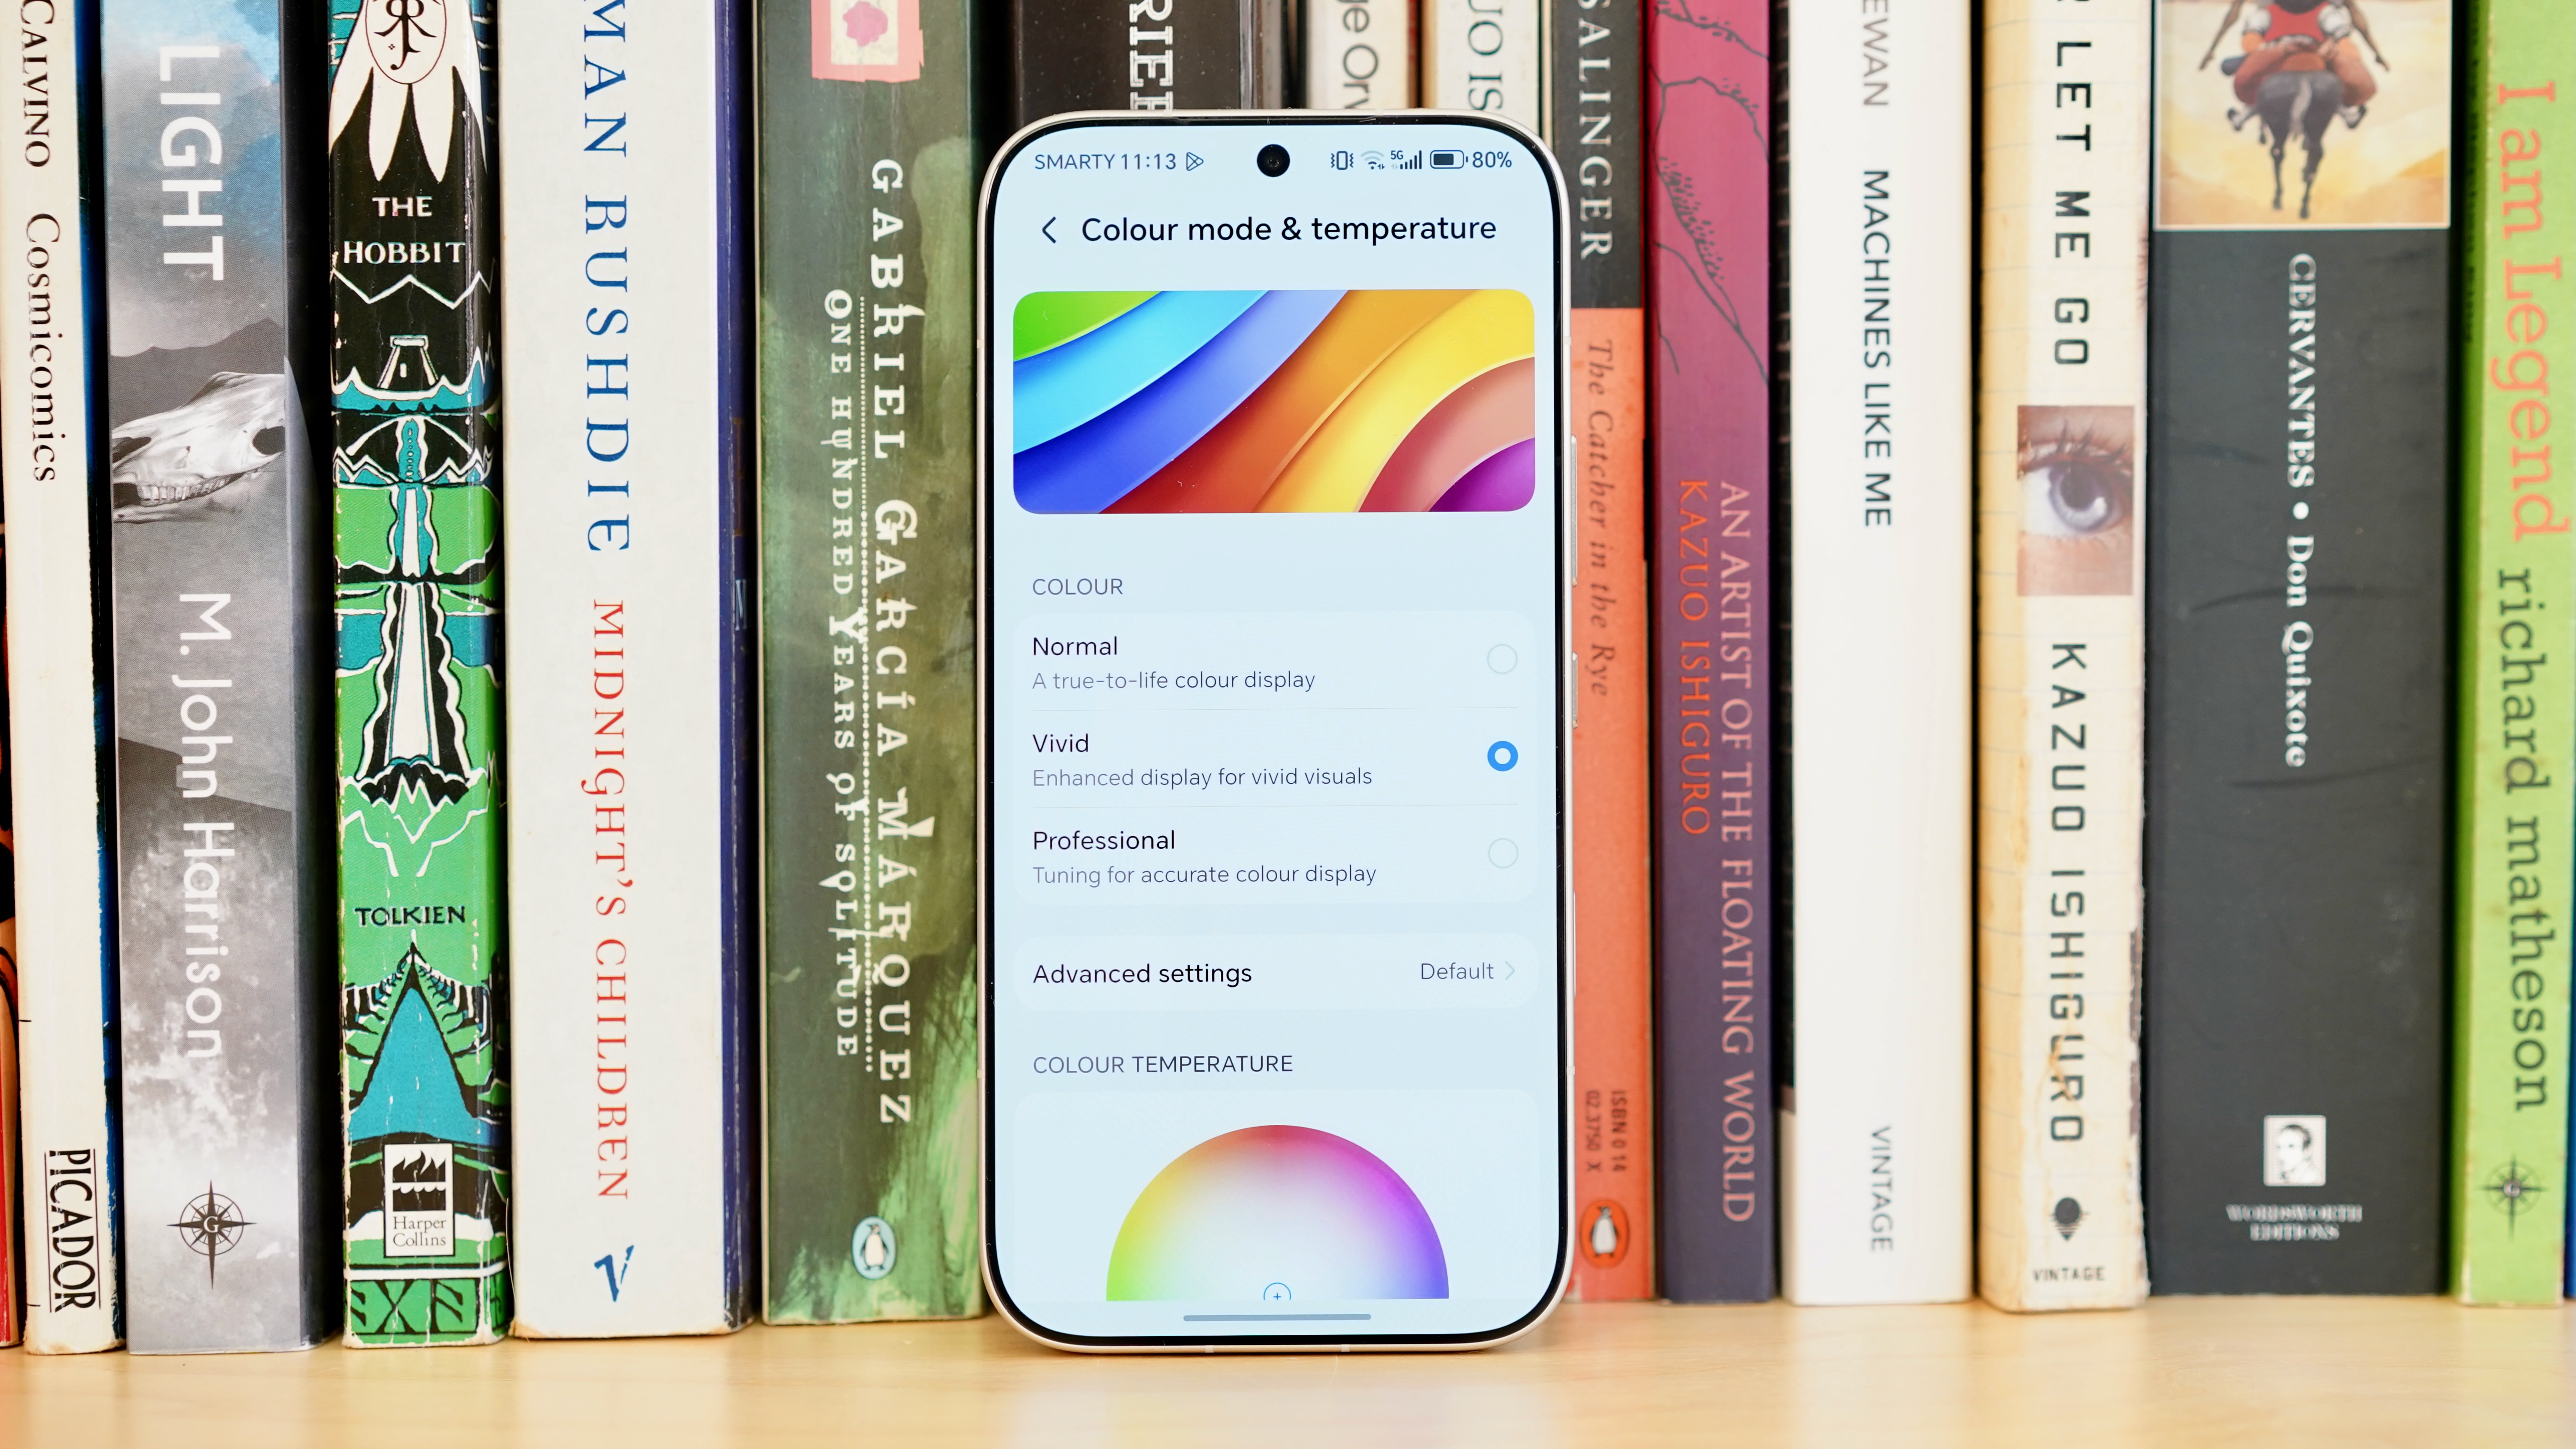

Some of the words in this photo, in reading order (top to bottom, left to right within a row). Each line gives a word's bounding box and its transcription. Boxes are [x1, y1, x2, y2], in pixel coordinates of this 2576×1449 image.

[21, 0, 54, 167] CALVINO
[2057, 42, 2091, 151] LET
[2497, 81, 2555, 105] I
[159, 46, 224, 280] LIGHT
[1035, 154, 1115, 169] SMARTY
[1122, 153, 1176, 170] 11:13
[1391, 150, 1403, 160] 5G
[1473, 151, 1512, 168] 80%
[2499, 128, 2543, 239] am
[372, 196, 432, 217] THE
[1082, 217, 1178, 241] Colour
[1189, 217, 1271, 240] mode
[1282, 217, 1301, 240] &
[1312, 217, 1496, 245] temperature
[2056, 192, 2090, 257] ME
[343, 242, 466, 264] HOBBIT
[1864, 171, 1890, 368] MACHINES
[824, 289, 852, 373] ONE
[871, 160, 926, 458] GABRIEL
[2055, 298, 2089, 364] GO
[26, 213, 65, 481] Cosmicomics
[586, 195, 629, 551] RUSHDIE
[1588, 340, 1614, 394] The
[2288, 254, 2315, 488] CERVANTES
[1865, 384, 1890, 458] LIKE
[2490, 257, 2570, 542] Legend
[821, 396, 858, 595] HUNDRED
[1589, 411, 1615, 528] Catcher
[1866, 474, 1891, 526] ME
[1721, 481, 1750, 537] AN
[1033, 578, 1122, 595] COLOUR
[1590, 541, 1608, 568] in
[1680, 480, 1708, 620] KAZUO
[2287, 536, 2314, 607] Don
[180, 593, 232, 655] M.
[875, 500, 917, 756] GARCÍA
[1591, 583, 1617, 628] the
[1721, 551, 1751, 688] ARTIST
[829, 607, 865, 749] YEARS
[1032, 673, 1046, 689] A
[1053, 671, 1167, 689] true-to-life
[1176, 671, 1238, 688] colour
[1245, 671, 1315, 692] display
[1034, 636, 1116, 655] Normal
[1586, 644, 1615, 696] Rye
[2499, 569, 2551, 794] richard
[1722, 699, 1752, 749] OF
[2282, 621, 2313, 767] Quixote
[172, 674, 233, 798] John
[581, 600, 633, 915] MIDNIGHT'S
[1033, 734, 1088, 752] Vivid
[1681, 641, 1710, 834] ISHIGURO
[2052, 644, 2086, 831] KAZUO
[826, 772, 866, 821] OF
[1034, 769, 1133, 786] Enhanced
[1142, 768, 1211, 789] display
[1219, 768, 1245, 785] for
[1252, 768, 1296, 784] vivid
[1305, 767, 1371, 784] visuals
[1722, 762, 1752, 841] THE
[1033, 867, 1100, 887] Tuning
[1108, 866, 1134, 883] for
[1142, 867, 1229, 883] accurate
[1237, 865, 1299, 882] colour
[1306, 865, 1376, 886] display
[1035, 830, 1174, 850] Professional
[182, 822, 235, 1058] Harrison
[355, 906, 465, 926] TOLKIEN
[818, 844, 862, 1056] SOLITUDE
[872, 787, 935, 1123] MÁRQUEZ
[1034, 964, 1149, 983] Advanced
[1160, 964, 1251, 987] settings
[1422, 962, 1494, 979] Default
[1722, 860, 1753, 1053] FLOATING
[2507, 817, 2555, 1111] matheson
[2051, 870, 2084, 1141] ISHIGURO
[597, 939, 627, 1198] CHILDREN
[1034, 1056, 1124, 1073] COLOUR
[1132, 1055, 1293, 1072] TEMPERATURE
[1612, 1091, 1627, 1133] ISBN
[1723, 1071, 1755, 1221] WORLD
[393, 1216, 447, 1233] Harper
[1871, 1127, 1892, 1249] VINTAGE
[50, 1149, 96, 1312] PICADOR
[393, 1232, 446, 1247] Collins
[2034, 1267, 2103, 1281] VINTAGE
